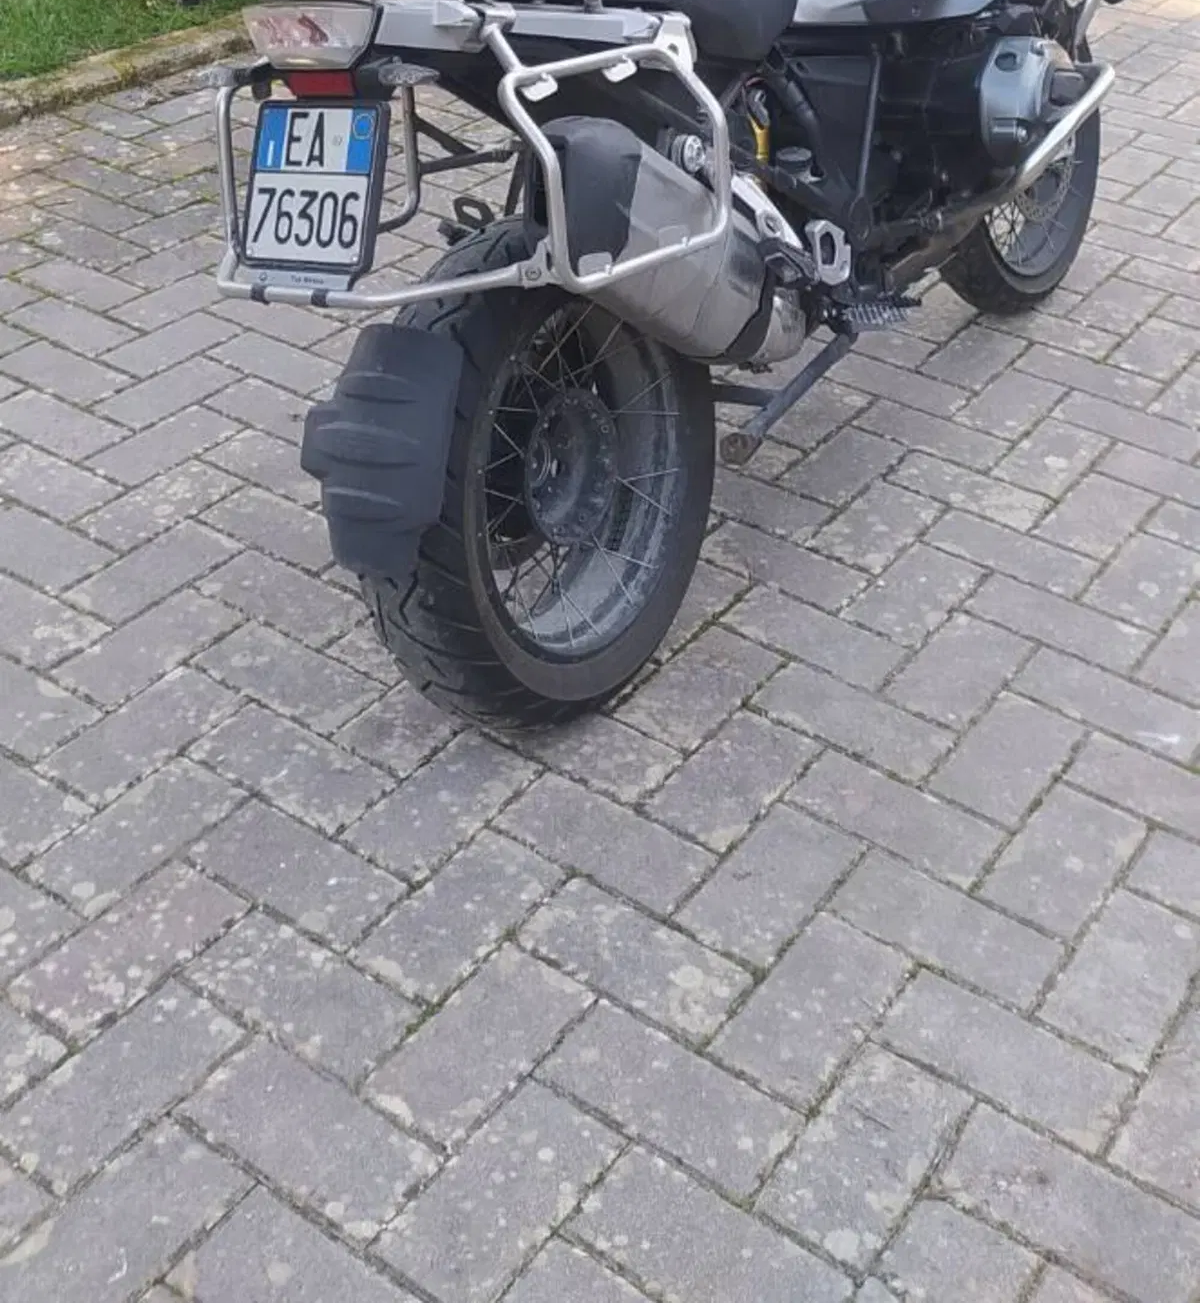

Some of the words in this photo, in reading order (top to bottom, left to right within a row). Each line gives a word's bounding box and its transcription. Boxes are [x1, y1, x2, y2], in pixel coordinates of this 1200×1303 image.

[267, 140, 275, 167] I
[285, 111, 325, 167] EA
[252, 187, 360, 249] 76306
